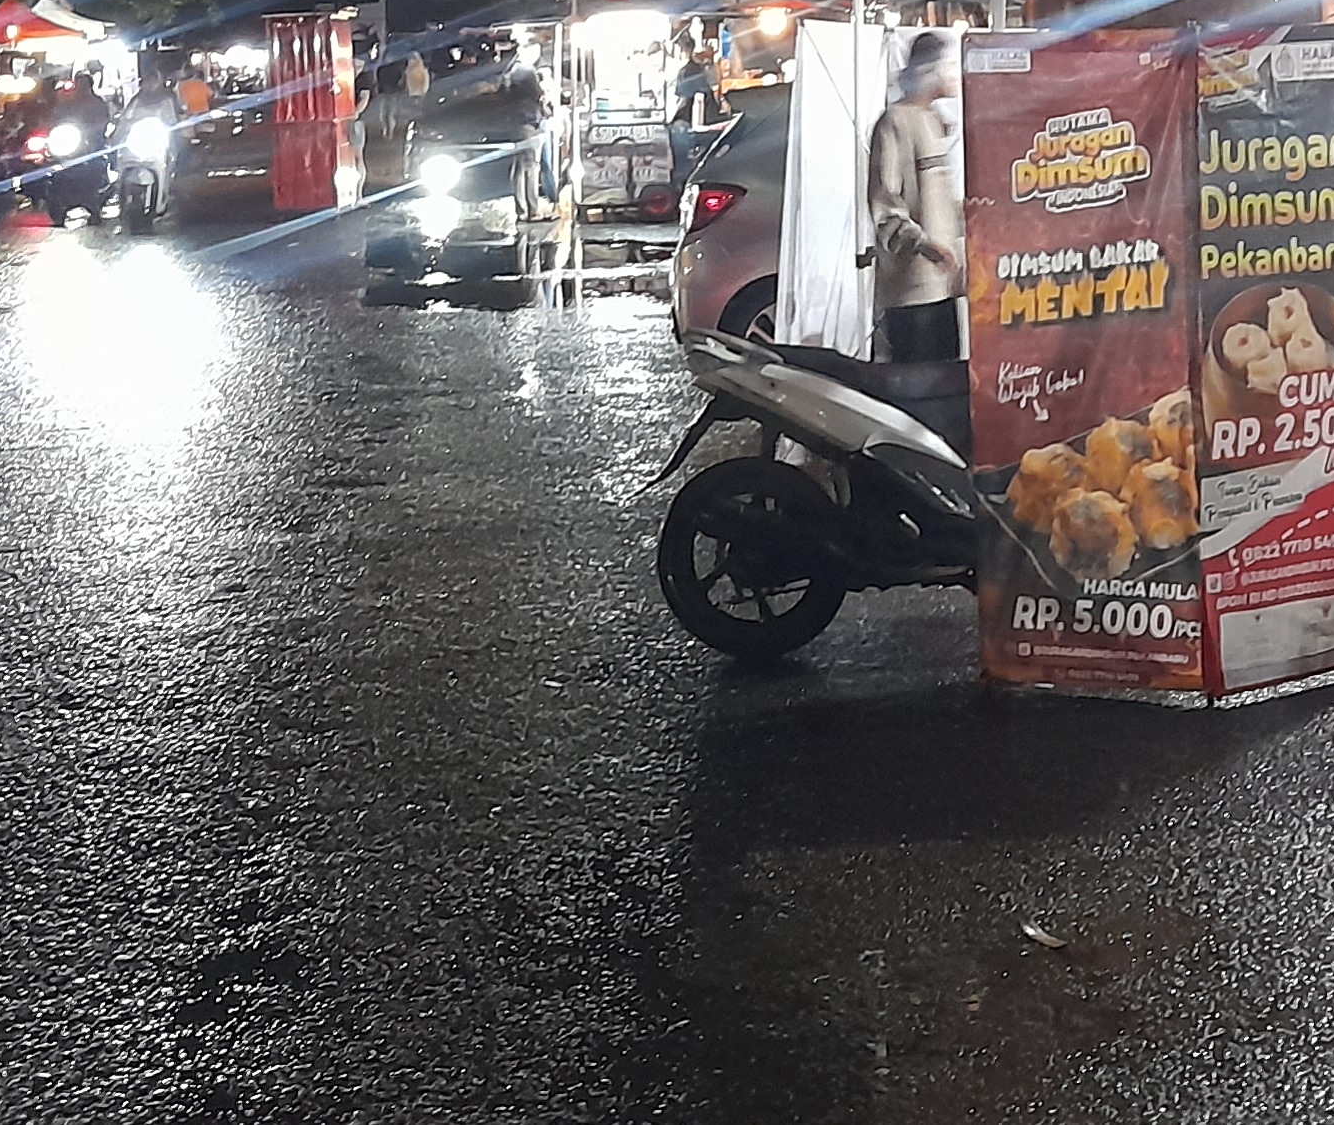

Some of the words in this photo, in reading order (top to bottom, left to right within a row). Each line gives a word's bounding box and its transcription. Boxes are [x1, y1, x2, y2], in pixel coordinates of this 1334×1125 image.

[1030, 126, 1131, 161] Juragan
[1017, 147, 1147, 195] Dimsum
[997, 247, 1084, 279] DIMSUM
[1089, 238, 1160, 269] BAKAR
[1000, 258, 1169, 325] MENTAI
[1212, 417, 1266, 460] RP.
[1083, 579, 1146, 597] HARGA
[1149, 581, 1199, 601] MULA
[1013, 595, 1064, 631] RP.
